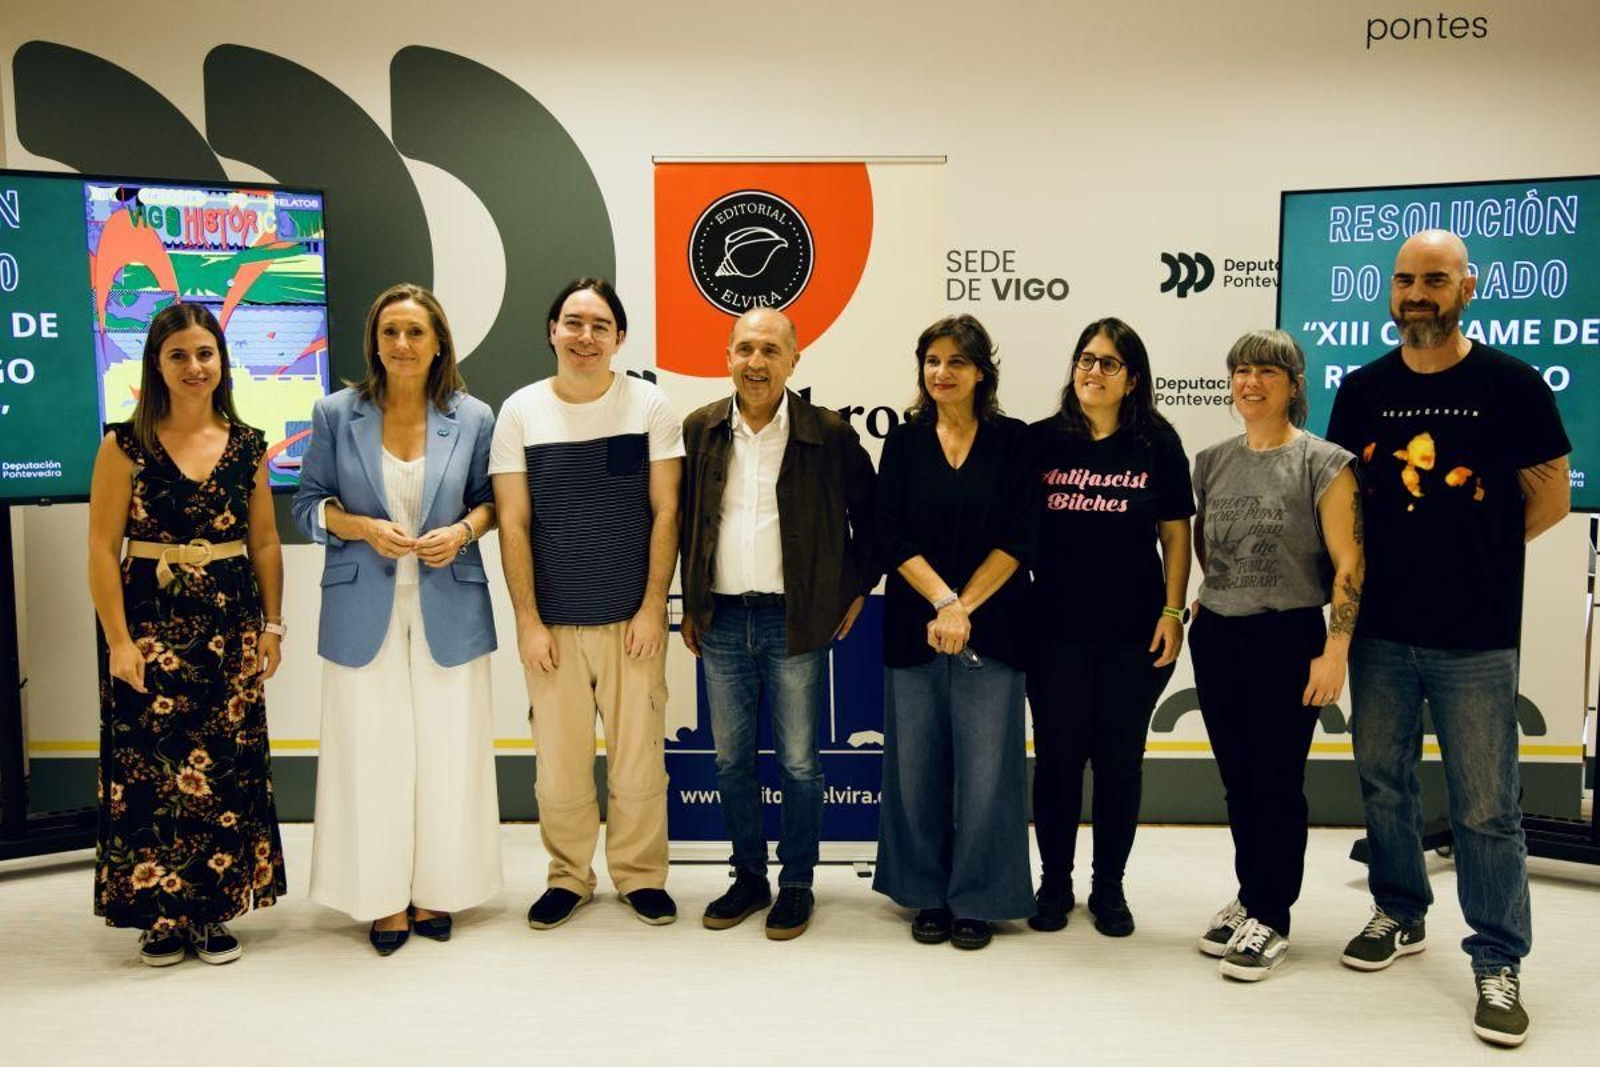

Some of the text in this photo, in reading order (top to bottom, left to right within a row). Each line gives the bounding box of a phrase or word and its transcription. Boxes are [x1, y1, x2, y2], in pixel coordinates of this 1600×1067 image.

[1366, 13, 1488, 50] pontes
[715, 202, 787, 225] EDITORIAL
[946, 250, 1016, 274] SEDE
[946, 278, 1070, 301] DE VIGO
[1223, 275, 1280, 288] Pontev
[1331, 264, 1381, 302] DO
[721, 288, 782, 309] ELVIRA
[12, 312, 59, 338] DE
[1553, 318, 1600, 345] DE
[1155, 377, 1230, 394] Deputaci
[2, 460, 61, 471] Deputación
[1041, 468, 1149, 490] Antifascist
[1047, 492, 1129, 512] Bitches
[1247, 521, 1285, 538] than
[1251, 539, 1279, 557] the
